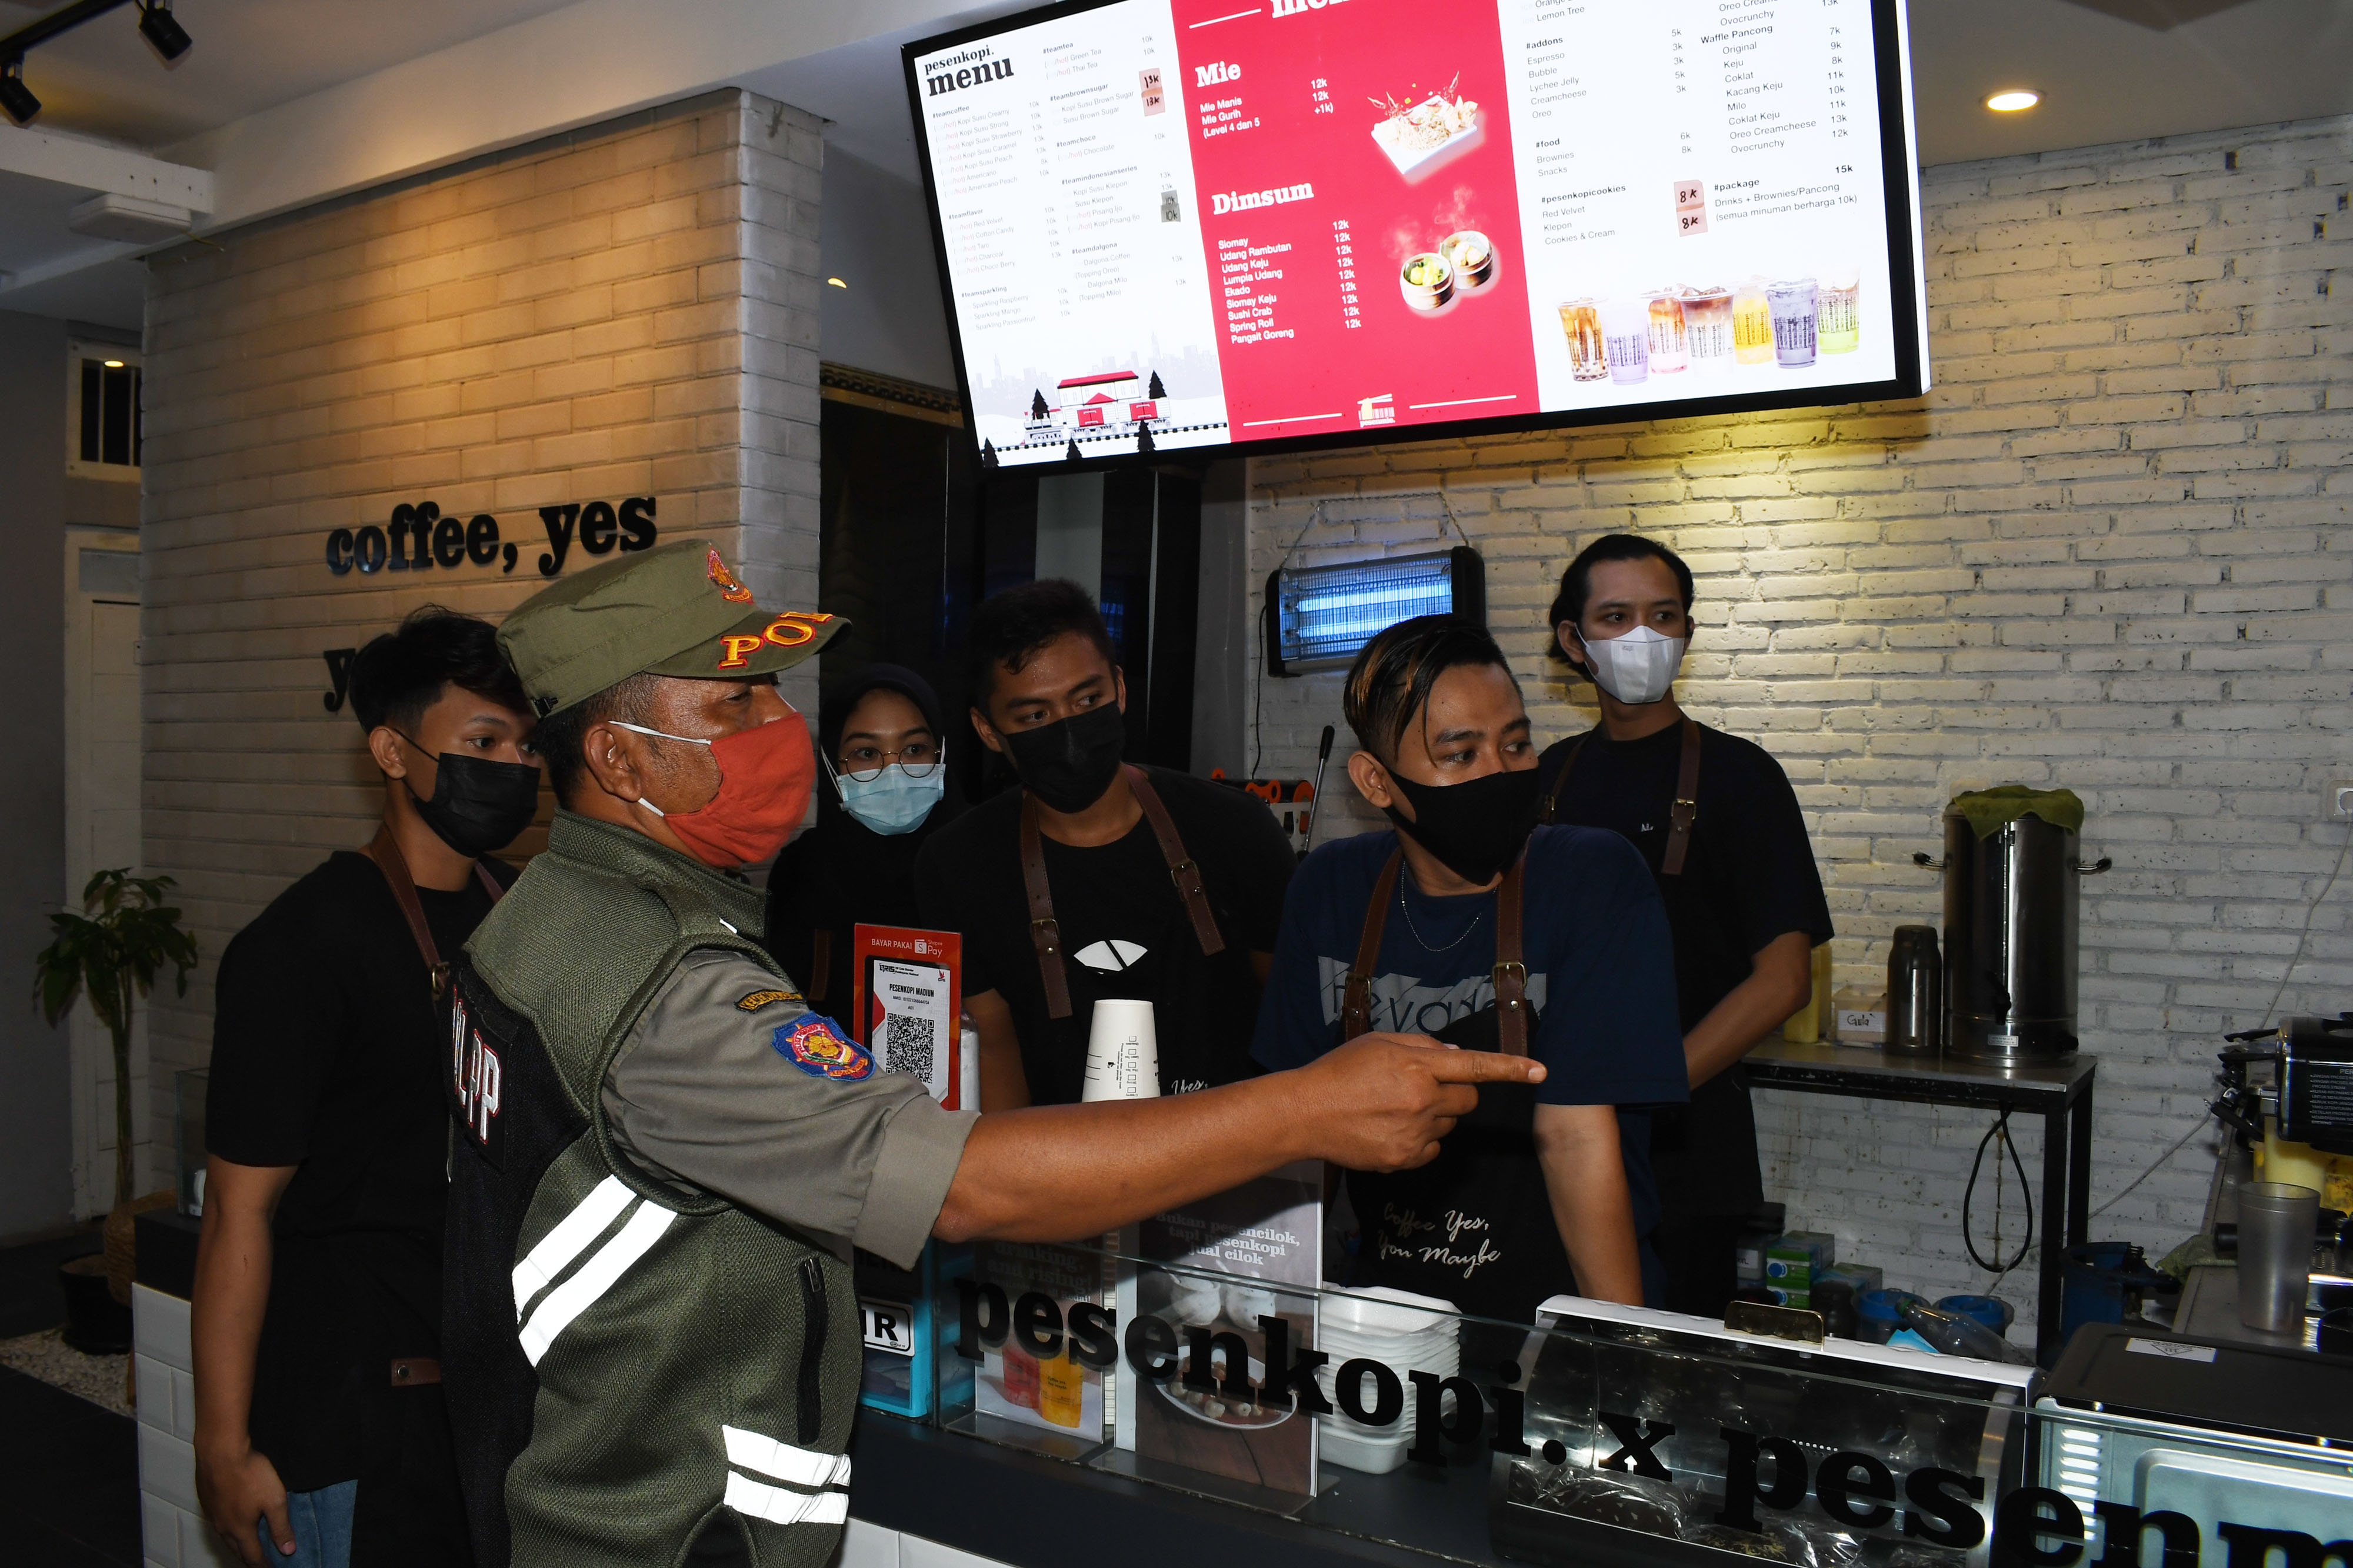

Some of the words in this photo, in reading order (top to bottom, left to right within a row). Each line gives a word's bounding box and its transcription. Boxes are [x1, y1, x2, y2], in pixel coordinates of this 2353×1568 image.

[1537, 11, 1565, 22] Lemon
[1567, 6, 1585, 15] Tree
[1720, 10, 1774, 26] Ovocrunchy
[1671, 28, 1682, 37] 5k
[1700, 32, 1729, 44] Waffle
[1731, 25, 1774, 39] Pancong
[1829, 26, 1841, 35] 7k
[1042, 42, 1074, 54] #teamtea
[1526, 37, 1563, 49] #addons
[1672, 42, 1683, 51] 3k
[1722, 41, 1757, 54] Original
[1830, 41, 1842, 50] 9k
[924, 44, 995, 75] pesenkopi.
[1527, 52, 1565, 65] Espresso
[1673, 56, 1684, 66] 3k
[1724, 59, 1744, 69] Keju
[1831, 56, 1843, 65] 8k
[926, 58, 1015, 97] menu
[1195, 61, 1241, 87] Mie
[1528, 66, 1557, 78] Bubble
[1675, 70, 1685, 79] 5k
[1725, 71, 1754, 83] Coklat
[1827, 70, 1844, 80] 11k
[1311, 78, 1328, 89] 12k
[1529, 81, 1558, 93] Lychee
[1561, 76, 1579, 86] Jelly
[1676, 84, 1687, 93] 3k
[1726, 86, 1760, 97] Kacang
[1762, 81, 1783, 91] Keju
[1050, 84, 1108, 101] #teambrownsugar
[1312, 90, 1329, 102] 12k
[1828, 85, 1845, 95] 10k
[1531, 89, 1587, 105] Creamcheese
[1199, 102, 1215, 113] Mie
[1217, 96, 1242, 109] Manis
[1314, 102, 1334, 114] +1k)
[1727, 102, 1747, 113] Milo
[1829, 99, 1847, 109] 11k
[932, 105, 969, 118] #teamcoffee
[1201, 114, 1217, 125] Mie
[1218, 109, 1241, 121] Gurih
[1532, 110, 1552, 118] Oreo
[1728, 114, 1758, 125] Coklat
[1759, 111, 1780, 121] Keju
[1831, 114, 1848, 124] 13k
[1203, 124, 1228, 139] (Level
[1229, 122, 1235, 131] 4
[1236, 121, 1252, 130] dan
[1254, 117, 1260, 126] 5
[1729, 131, 1751, 141] Oreo
[1754, 120, 1817, 136] Creamcheese
[1832, 128, 1848, 138] 12k
[1056, 135, 1096, 148] #teamchoco
[1680, 132, 1691, 140] 6k
[1535, 138, 1560, 148] #food
[1731, 139, 1785, 154] Ovocrunchy
[1681, 145, 1692, 154] 8k
[1537, 152, 1574, 164] Brownies
[1061, 165, 1138, 185] #teamindonesianseries
[1538, 166, 1568, 176] Snacks
[1835, 164, 1854, 174] 15k
[1714, 179, 1759, 192] #package
[1211, 182, 1314, 215] Dimsum
[1541, 185, 1626, 205] #pesenkopicookies
[1715, 197, 1743, 207] Drinks
[1754, 184, 1839, 202] Brownies/Pancong
[948, 209, 983, 219] #teamflavor
[1542, 209, 1558, 218] Red
[1560, 205, 1585, 215] Velvet
[1716, 211, 1748, 222] (semua
[1751, 205, 1792, 216] minuman
[1794, 199, 1835, 210] berharga
[1838, 194, 1857, 204] 10k)
[1332, 219, 1349, 230] 12k
[1544, 222, 1572, 232] Klepon
[1334, 232, 1351, 242] 12k
[1545, 235, 1578, 245] Cookies
[1588, 229, 1615, 239] Cream
[1072, 242, 1117, 254] #teamdalgona
[1218, 238, 1248, 249] Siomay
[1335, 244, 1352, 255] 12k
[1219, 250, 1247, 261] Udang
[1248, 243, 1292, 256] Rambutan
[1221, 262, 1248, 273] Udang
[1249, 258, 1269, 269] Keju
[1337, 256, 1354, 268] 12k
[1223, 272, 1254, 285] Lumpia
[1254, 269, 1283, 281] Udang
[1338, 269, 1355, 279] 12k
[961, 286, 1007, 298] #teamsparkling
[1224, 285, 1251, 297] Ekado
[1340, 281, 1357, 292] 12k
[1226, 298, 1257, 309] Siomay
[1258, 293, 1277, 305] Keju
[1341, 293, 1358, 304] 12k
[1228, 308, 1251, 321] Sushi
[1251, 306, 1272, 317] Crab
[1343, 306, 1360, 316] 12k
[1229, 321, 1257, 333] Spring
[1257, 317, 1274, 328] Roll
[1345, 318, 1361, 328] 12k
[1231, 331, 1262, 344] Pangsit
[1263, 329, 1294, 339] Goreng
[326, 501, 519, 576] coffee,
[538, 497, 658, 576] yes
[871, 938, 892, 948] BAYAR
[893, 941, 912, 949] PAKAI
[928, 946, 943, 958] Pay
[889, 983, 915, 994] PESENKOPI
[915, 987, 934, 997] MADIUN
[1384, 1202, 1435, 1234] Coffee
[1444, 1209, 1489, 1241] Yes,
[1211, 1222, 1301, 1248] pesencilok,
[1205, 1233, 1287, 1258] pesenkopi
[1224, 1246, 1264, 1266] cilok
[1378, 1232, 1412, 1260] You
[1419, 1239, 1501, 1279] Maybe
[954, 1276, 1568, 1467] pesenkopi.
[1597, 1411, 1676, 1483] x
